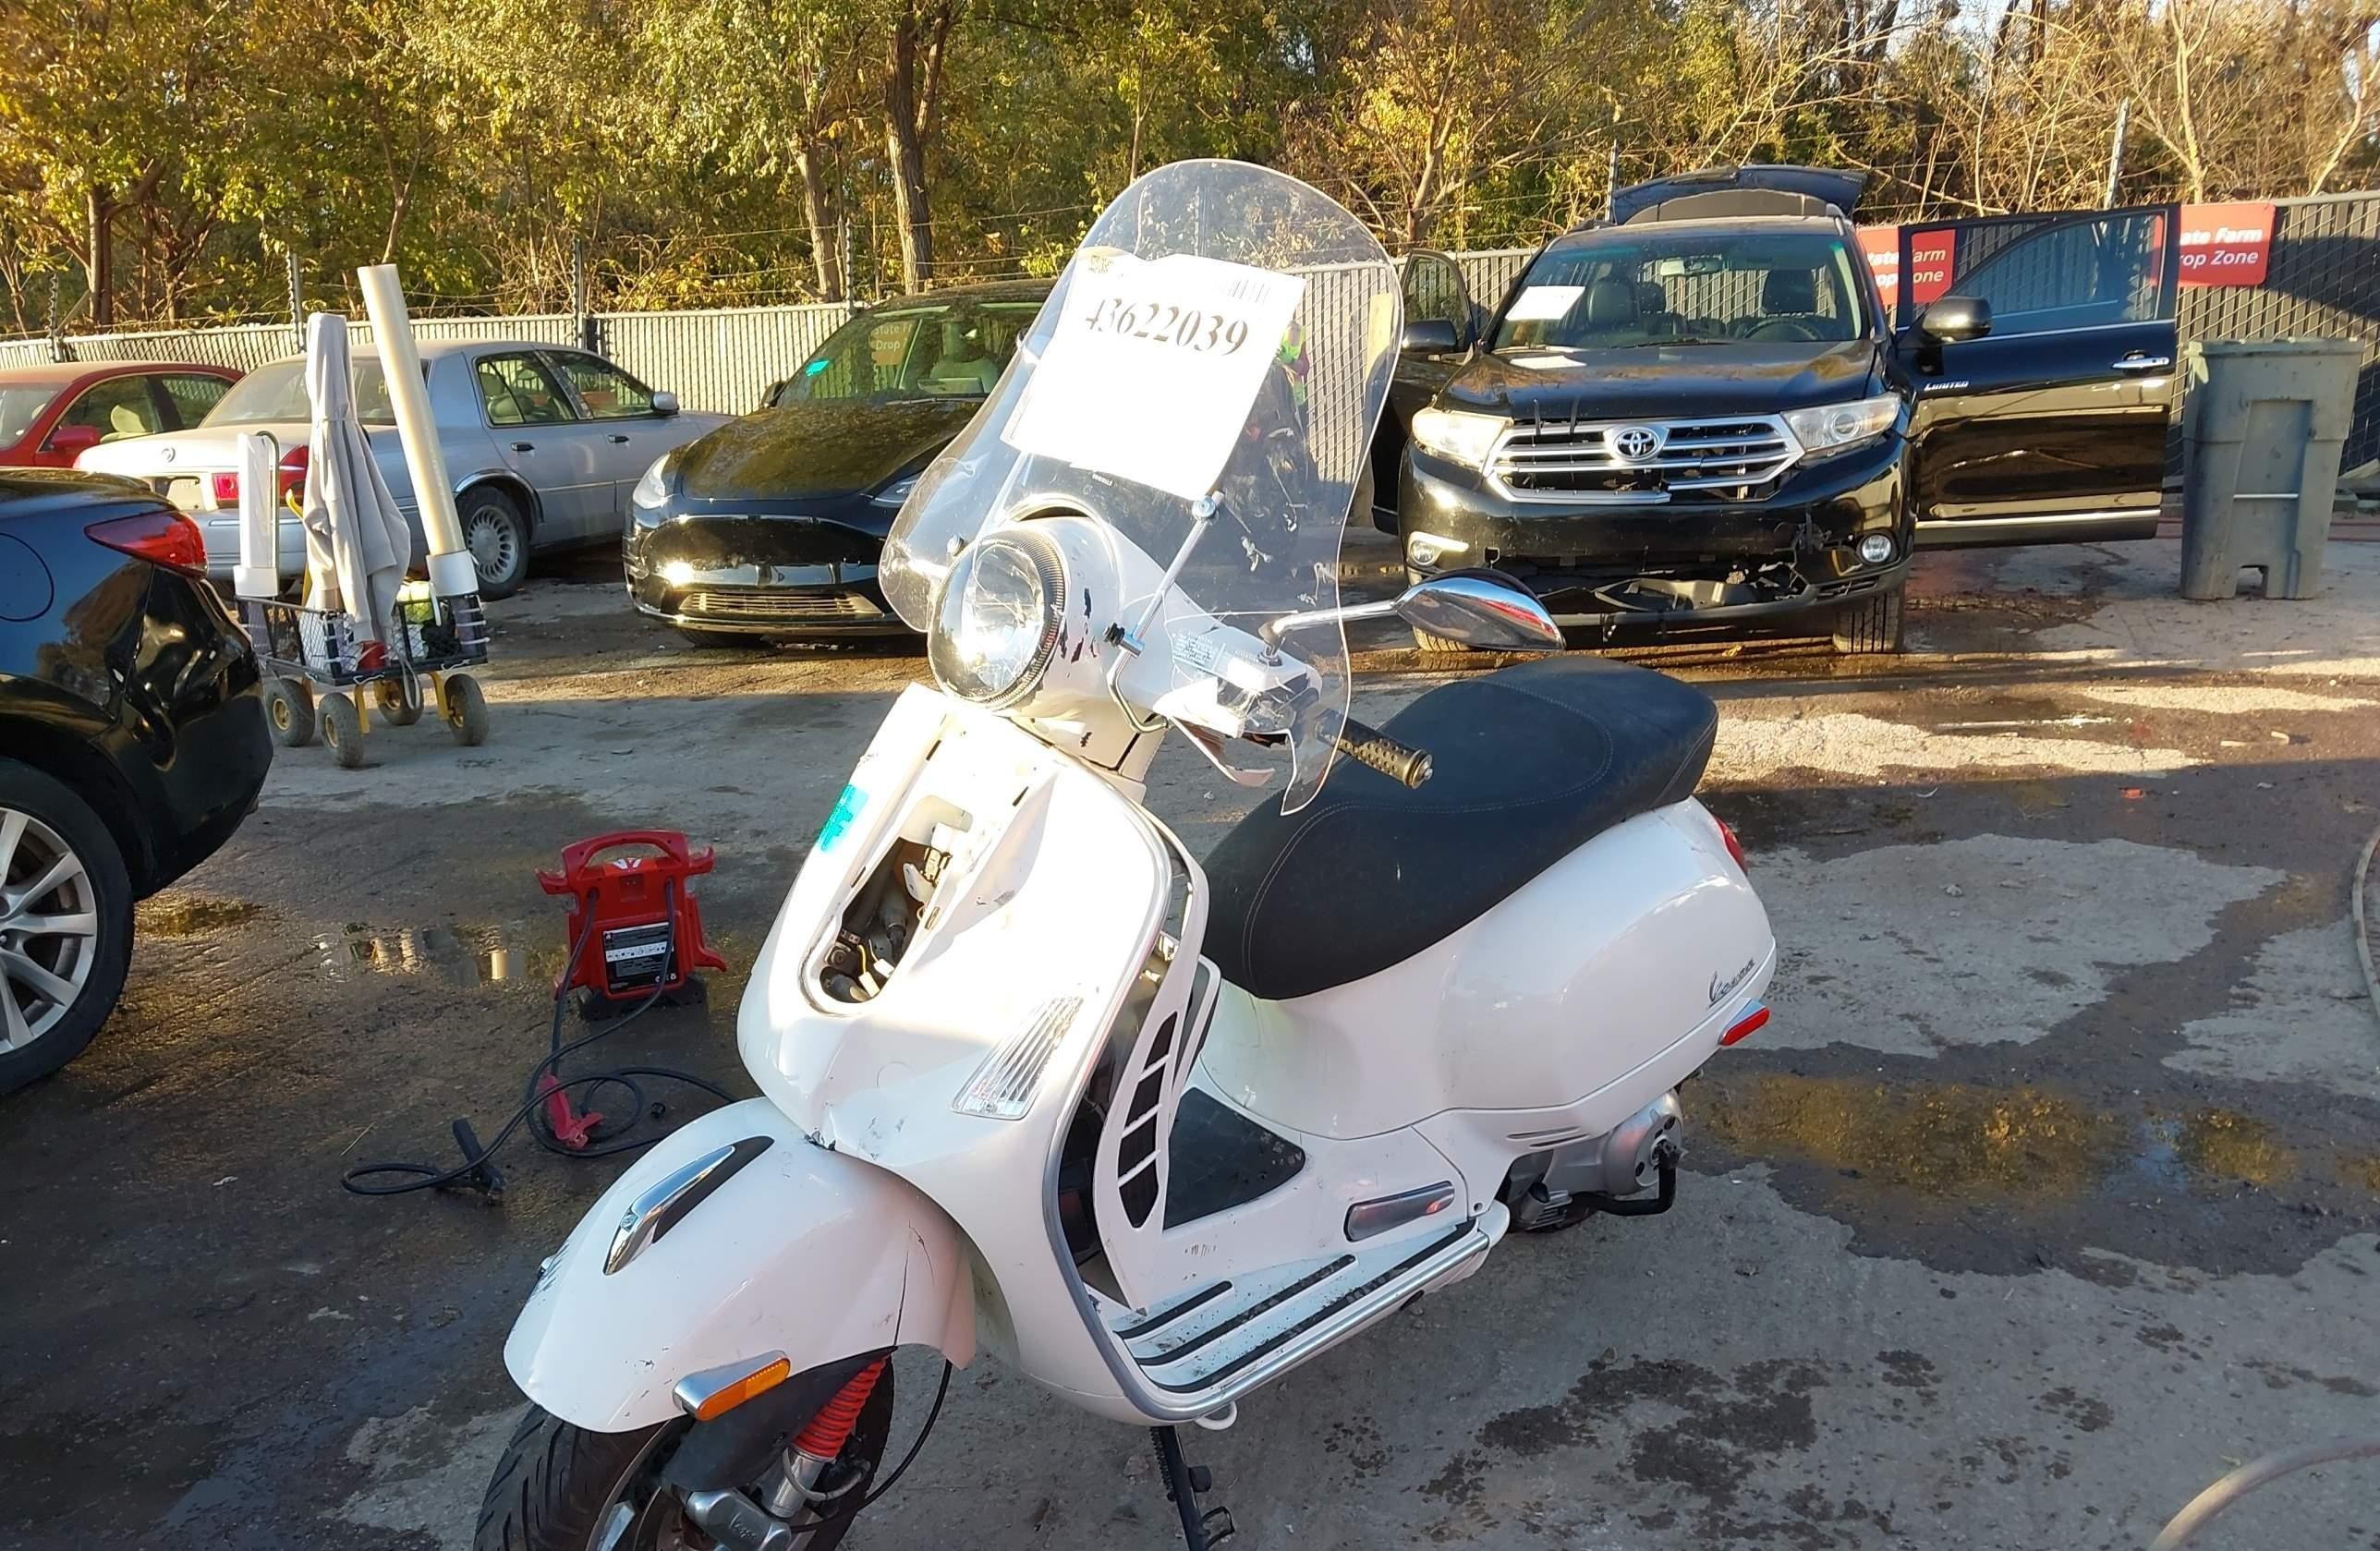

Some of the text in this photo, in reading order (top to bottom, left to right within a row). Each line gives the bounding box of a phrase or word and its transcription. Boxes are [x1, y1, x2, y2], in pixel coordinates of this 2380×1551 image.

[2180, 227, 2263, 246] ate Farm
[1867, 249, 1946, 266] tate arm
[2180, 249, 2259, 270] op Zone
[1876, 270, 1944, 289] op one
[1084, 297, 1249, 357] 43622039
[875, 340, 901, 352] Drop
